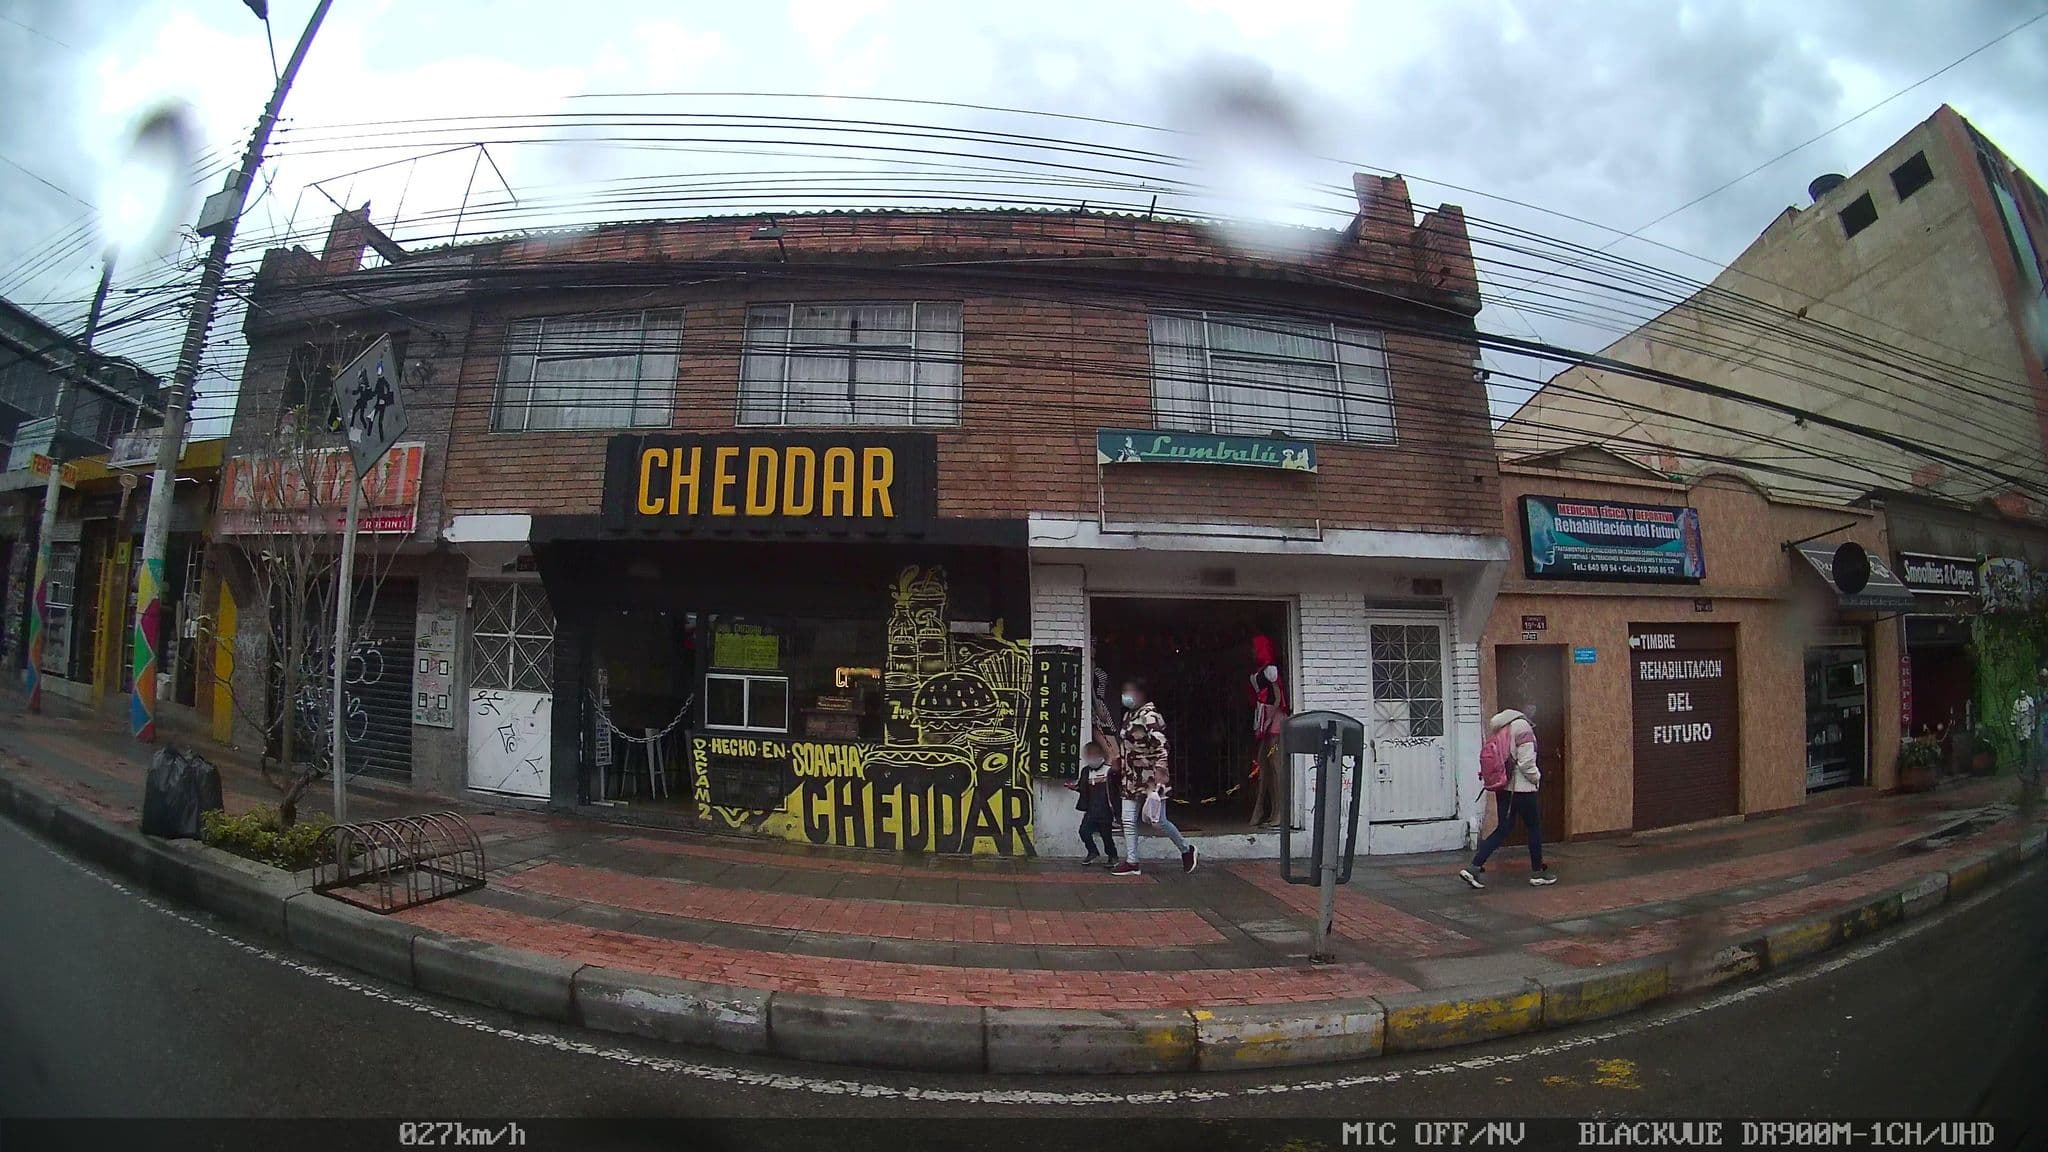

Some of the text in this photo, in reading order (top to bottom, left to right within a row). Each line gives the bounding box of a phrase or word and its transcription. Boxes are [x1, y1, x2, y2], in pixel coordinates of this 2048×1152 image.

[1140, 436, 1279, 463] Lumbalú
[638, 446, 895, 517] CHEDDAR
[1557, 503, 1600, 518] MEDICINA
[1626, 509, 1634, 520] Y
[1635, 510, 1675, 524] DEPORTIVA
[1554, 517, 1681, 540] Rehabilitación del Futuro
[1904, 560, 1944, 585] Smoothies
[1950, 564, 1975, 590] Crepes
[1640, 634, 1676, 650] TIMBRE
[1640, 660, 1722, 680] REHABILITACION
[1667, 692, 1693, 712] DEL
[1039, 661, 1050, 772] DISFRACES
[1060, 661, 1068, 774] TRAJES
[1070, 663, 1079, 774] TIPICOS
[1653, 723, 1712, 744] FUTURO
[711, 738, 865, 780] HECHO EN SOACHA
[802, 779, 1037, 858] CHEDDAR
